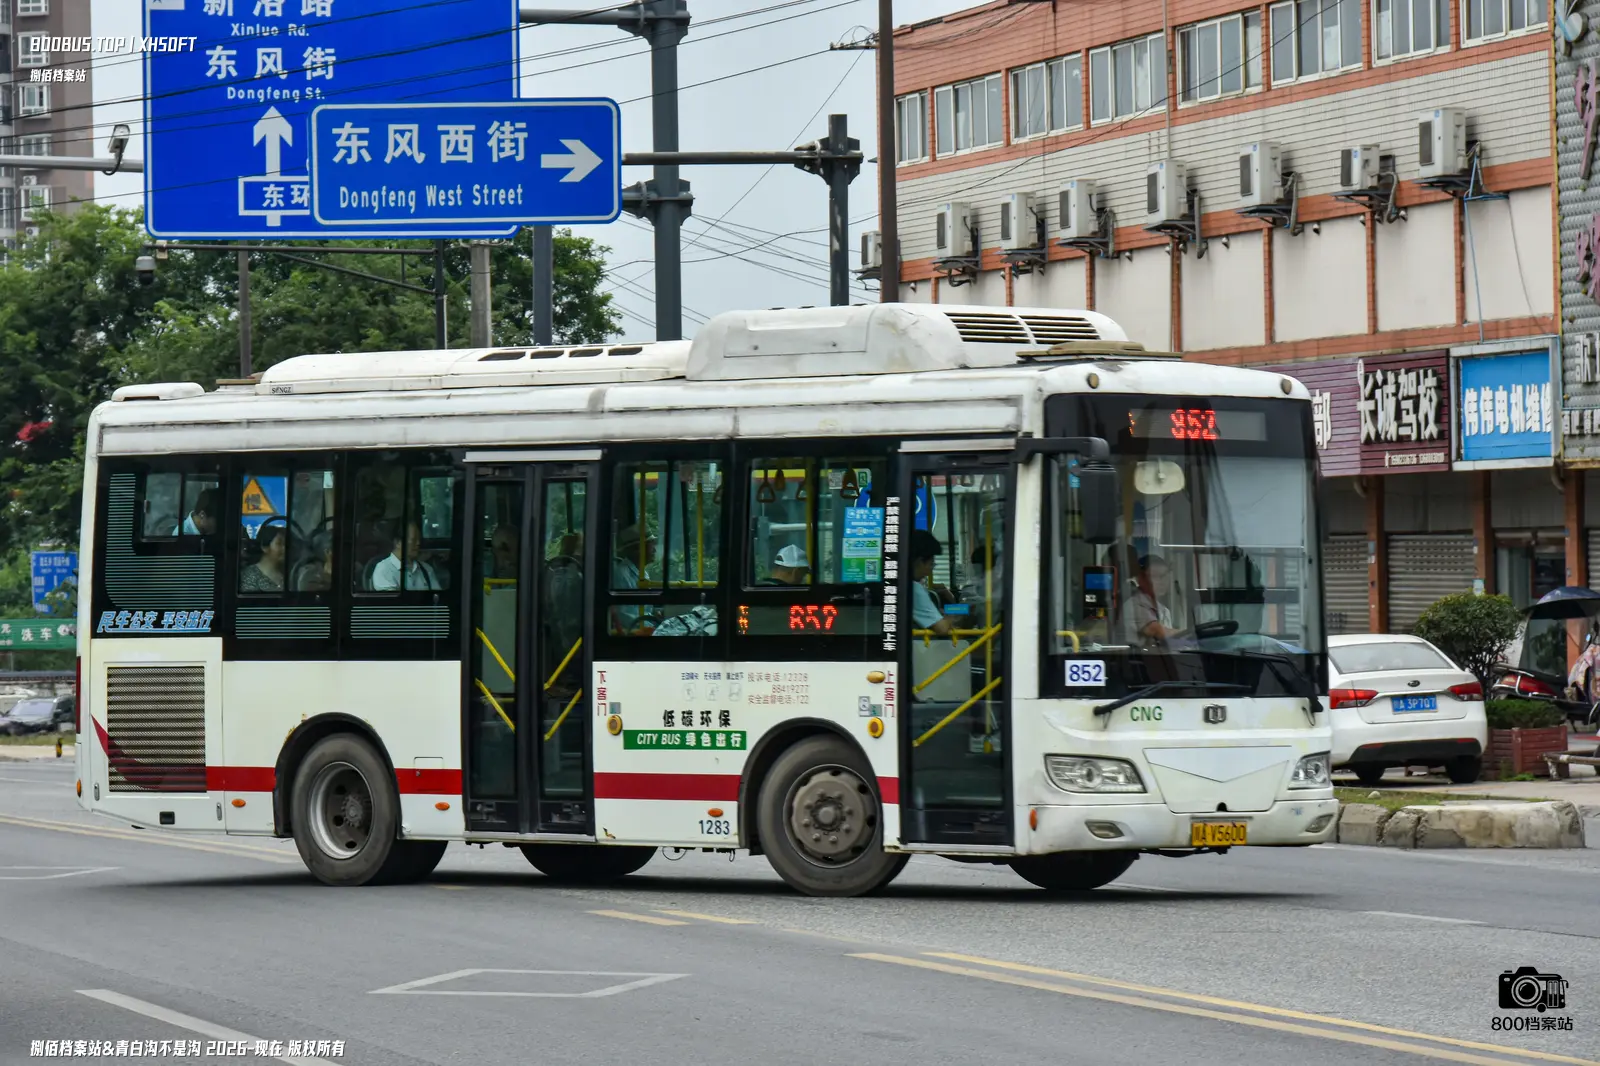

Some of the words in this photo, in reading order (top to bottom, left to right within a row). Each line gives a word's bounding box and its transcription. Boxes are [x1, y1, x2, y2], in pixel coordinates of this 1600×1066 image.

[231, 23, 280, 37] Xinluo
[288, 23, 310, 37] Rd.
[205, 45, 337, 80] 东风街
[227, 87, 300, 103] Dongfeng
[305, 87, 326, 99] St.
[332, 121, 528, 165] 东风西街
[340, 186, 416, 213] Dongfeng
[426, 184, 463, 208] West
[473, 183, 524, 206] Street
[1357, 359, 1439, 444] 长诚驾校
[97, 610, 158, 632] 民生公交
[161, 610, 215, 630] 平安出行
[1069, 664, 1103, 683] 852
[597, 670, 607, 717] 下客门
[884, 670, 895, 718] 上客门
[663, 709, 731, 728] 低碳环保
[1130, 705, 1164, 722] CNG
[637, 733, 658, 745] CITY
[661, 733, 681, 746] BUS
[685, 732, 742, 748] 绿色出行
[698, 820, 731, 836] 1283
